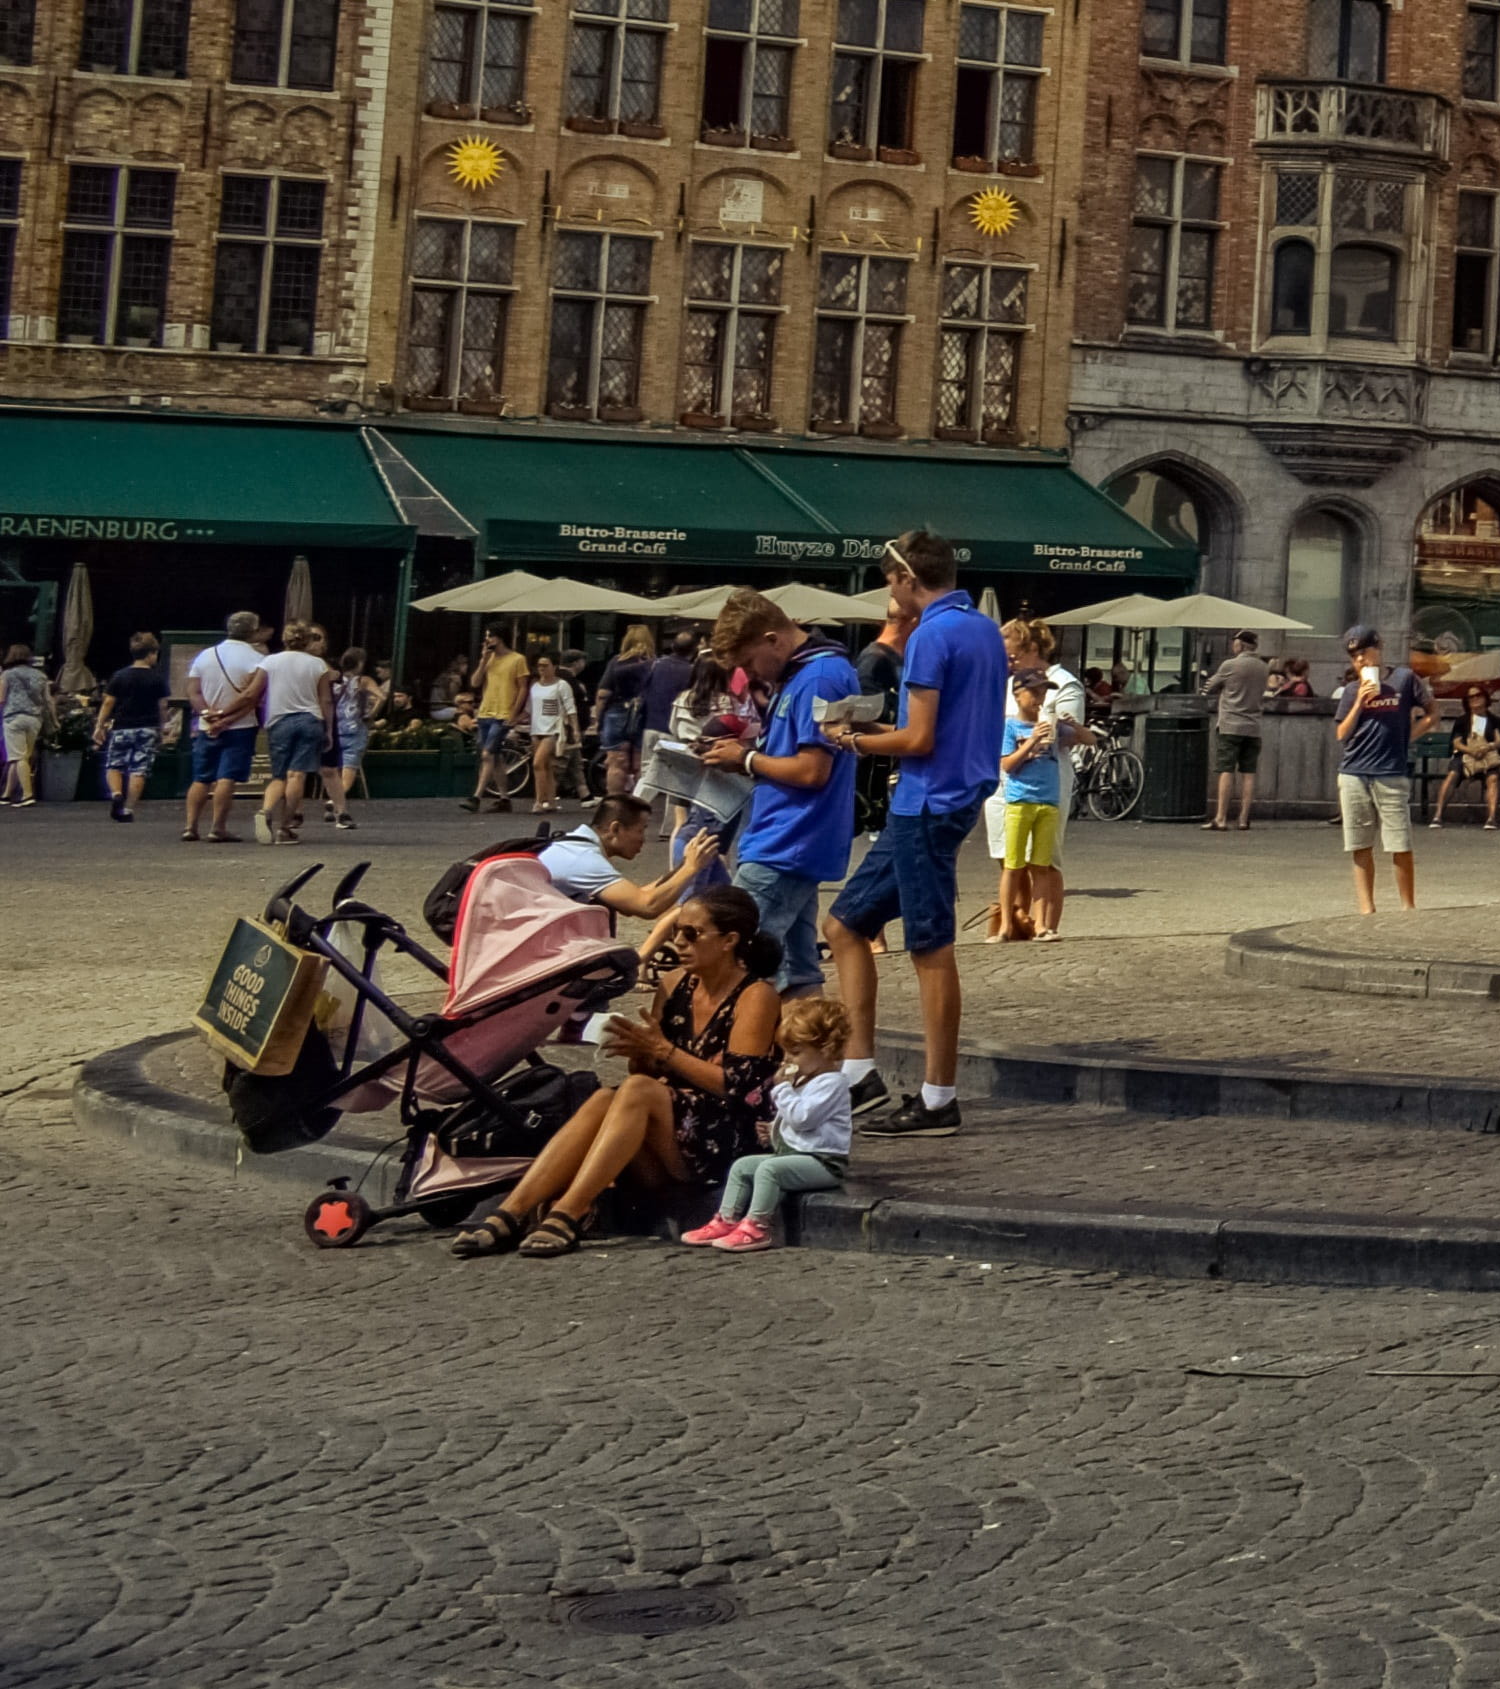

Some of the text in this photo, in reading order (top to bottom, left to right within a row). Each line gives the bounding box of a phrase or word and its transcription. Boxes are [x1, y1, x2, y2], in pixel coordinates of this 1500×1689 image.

[560, 524, 687, 541] Bistro-Brasserie
[578, 540, 667, 555] Grand-Café
[756, 535, 835, 560] Huyze
[1033, 544, 1143, 559] Bistro-Brasserie
[1050, 559, 1127, 572] Grand-Café
[233, 964, 265, 994] GOOD
[223, 979, 260, 1017] THINGS
[217, 999, 250, 1036] INSIDE
